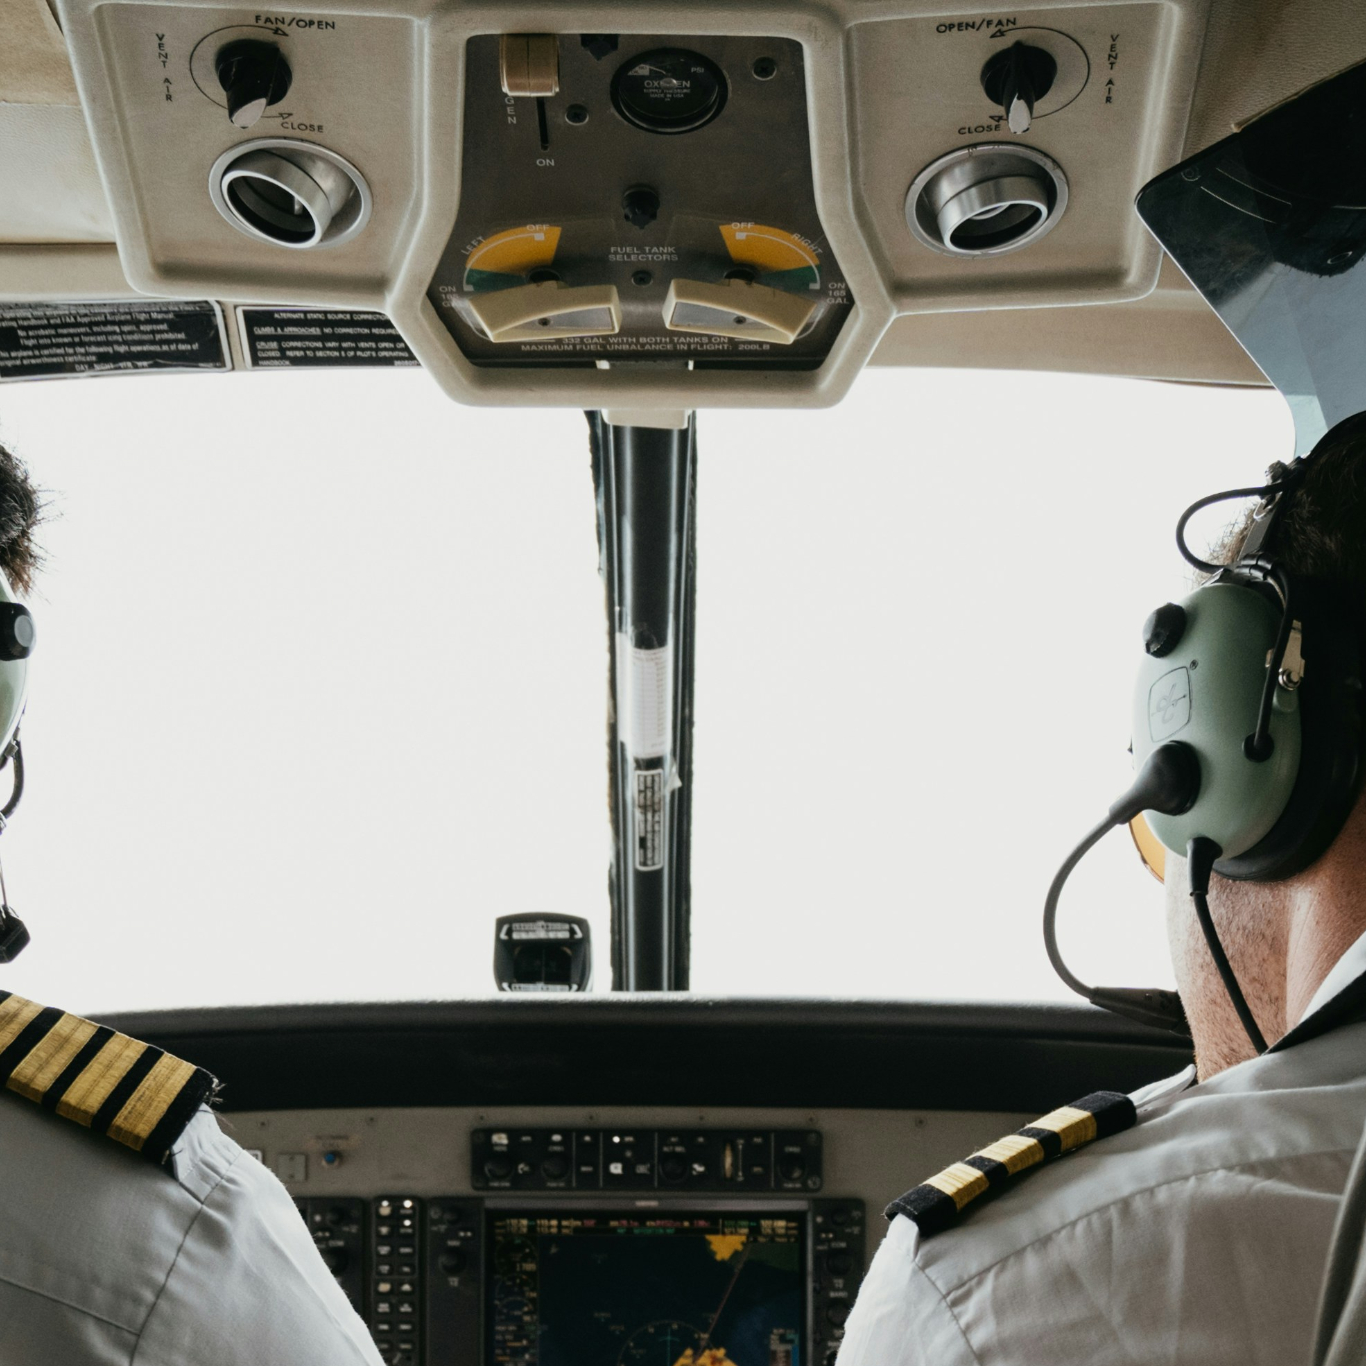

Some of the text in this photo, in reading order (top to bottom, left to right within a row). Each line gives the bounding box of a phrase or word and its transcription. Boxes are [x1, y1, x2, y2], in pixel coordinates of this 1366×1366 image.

[255, 15, 336, 30] FAN/OPEN
[935, 17, 1017, 34] OPEN/FAN
[156, 33, 173, 102] VENT AIR
[1105, 34, 1120, 104] VENT AIR
[644, 80, 690, 88] OXEN
[280, 121, 324, 134] CLOSE
[957, 123, 1002, 136] CLOSE
[536, 158, 555, 166] ON
[526, 224, 550, 232] OFF
[460, 235, 487, 256] LEFT
[792, 233, 823, 254] RIGHT
[77, 314, 106, 324] Approved
[106, 313, 132, 322] Airplane
[132, 312, 150, 320] Flight
